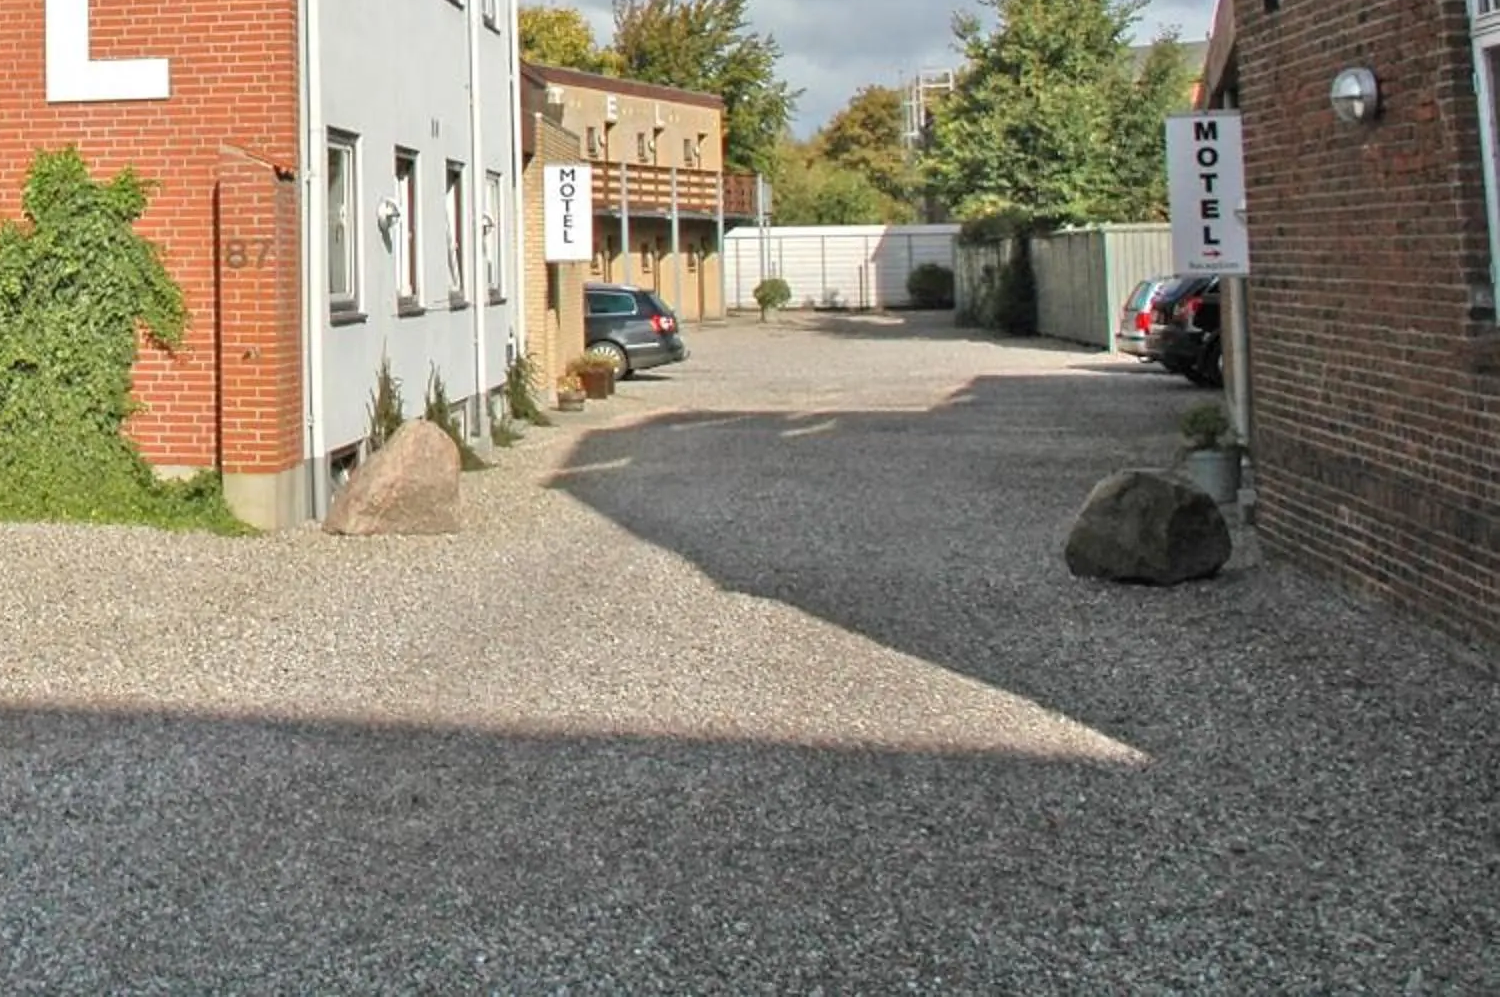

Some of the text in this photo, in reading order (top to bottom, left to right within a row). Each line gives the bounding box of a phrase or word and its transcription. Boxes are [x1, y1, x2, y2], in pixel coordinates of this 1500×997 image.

[558, 168, 576, 244] MOTEL
[1193, 120, 1221, 246] MOTEL
[225, 238, 274, 270] 87
